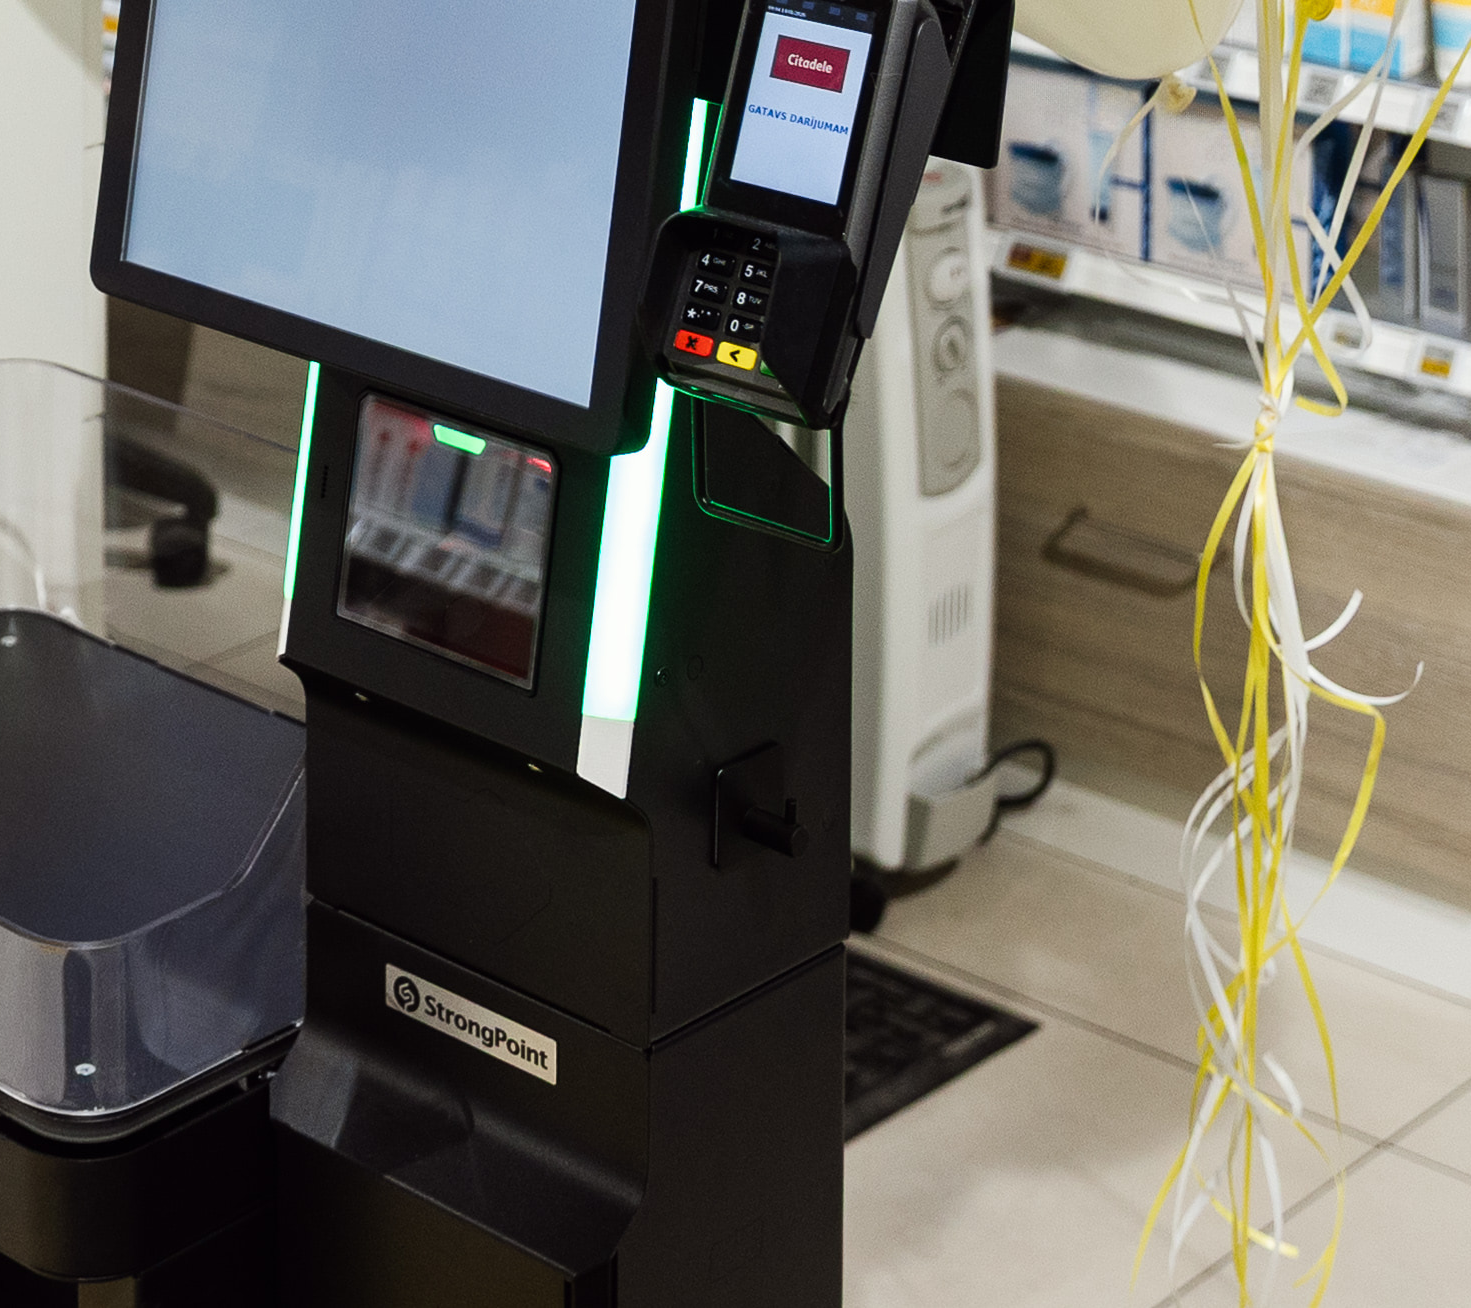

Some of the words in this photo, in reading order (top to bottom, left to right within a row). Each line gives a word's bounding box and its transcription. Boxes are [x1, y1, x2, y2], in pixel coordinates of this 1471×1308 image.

[787, 53, 834, 74] Citadele
[748, 103, 787, 122] GATAVS
[789, 112, 850, 136] DARĪJUMAM
[701, 253, 711, 267] 4
[744, 264, 754, 278] 5
[694, 279, 704, 293] 7
[736, 291, 746, 305] 8
[730, 319, 739, 332] 0
[423, 995, 549, 1071] StrongPoint
